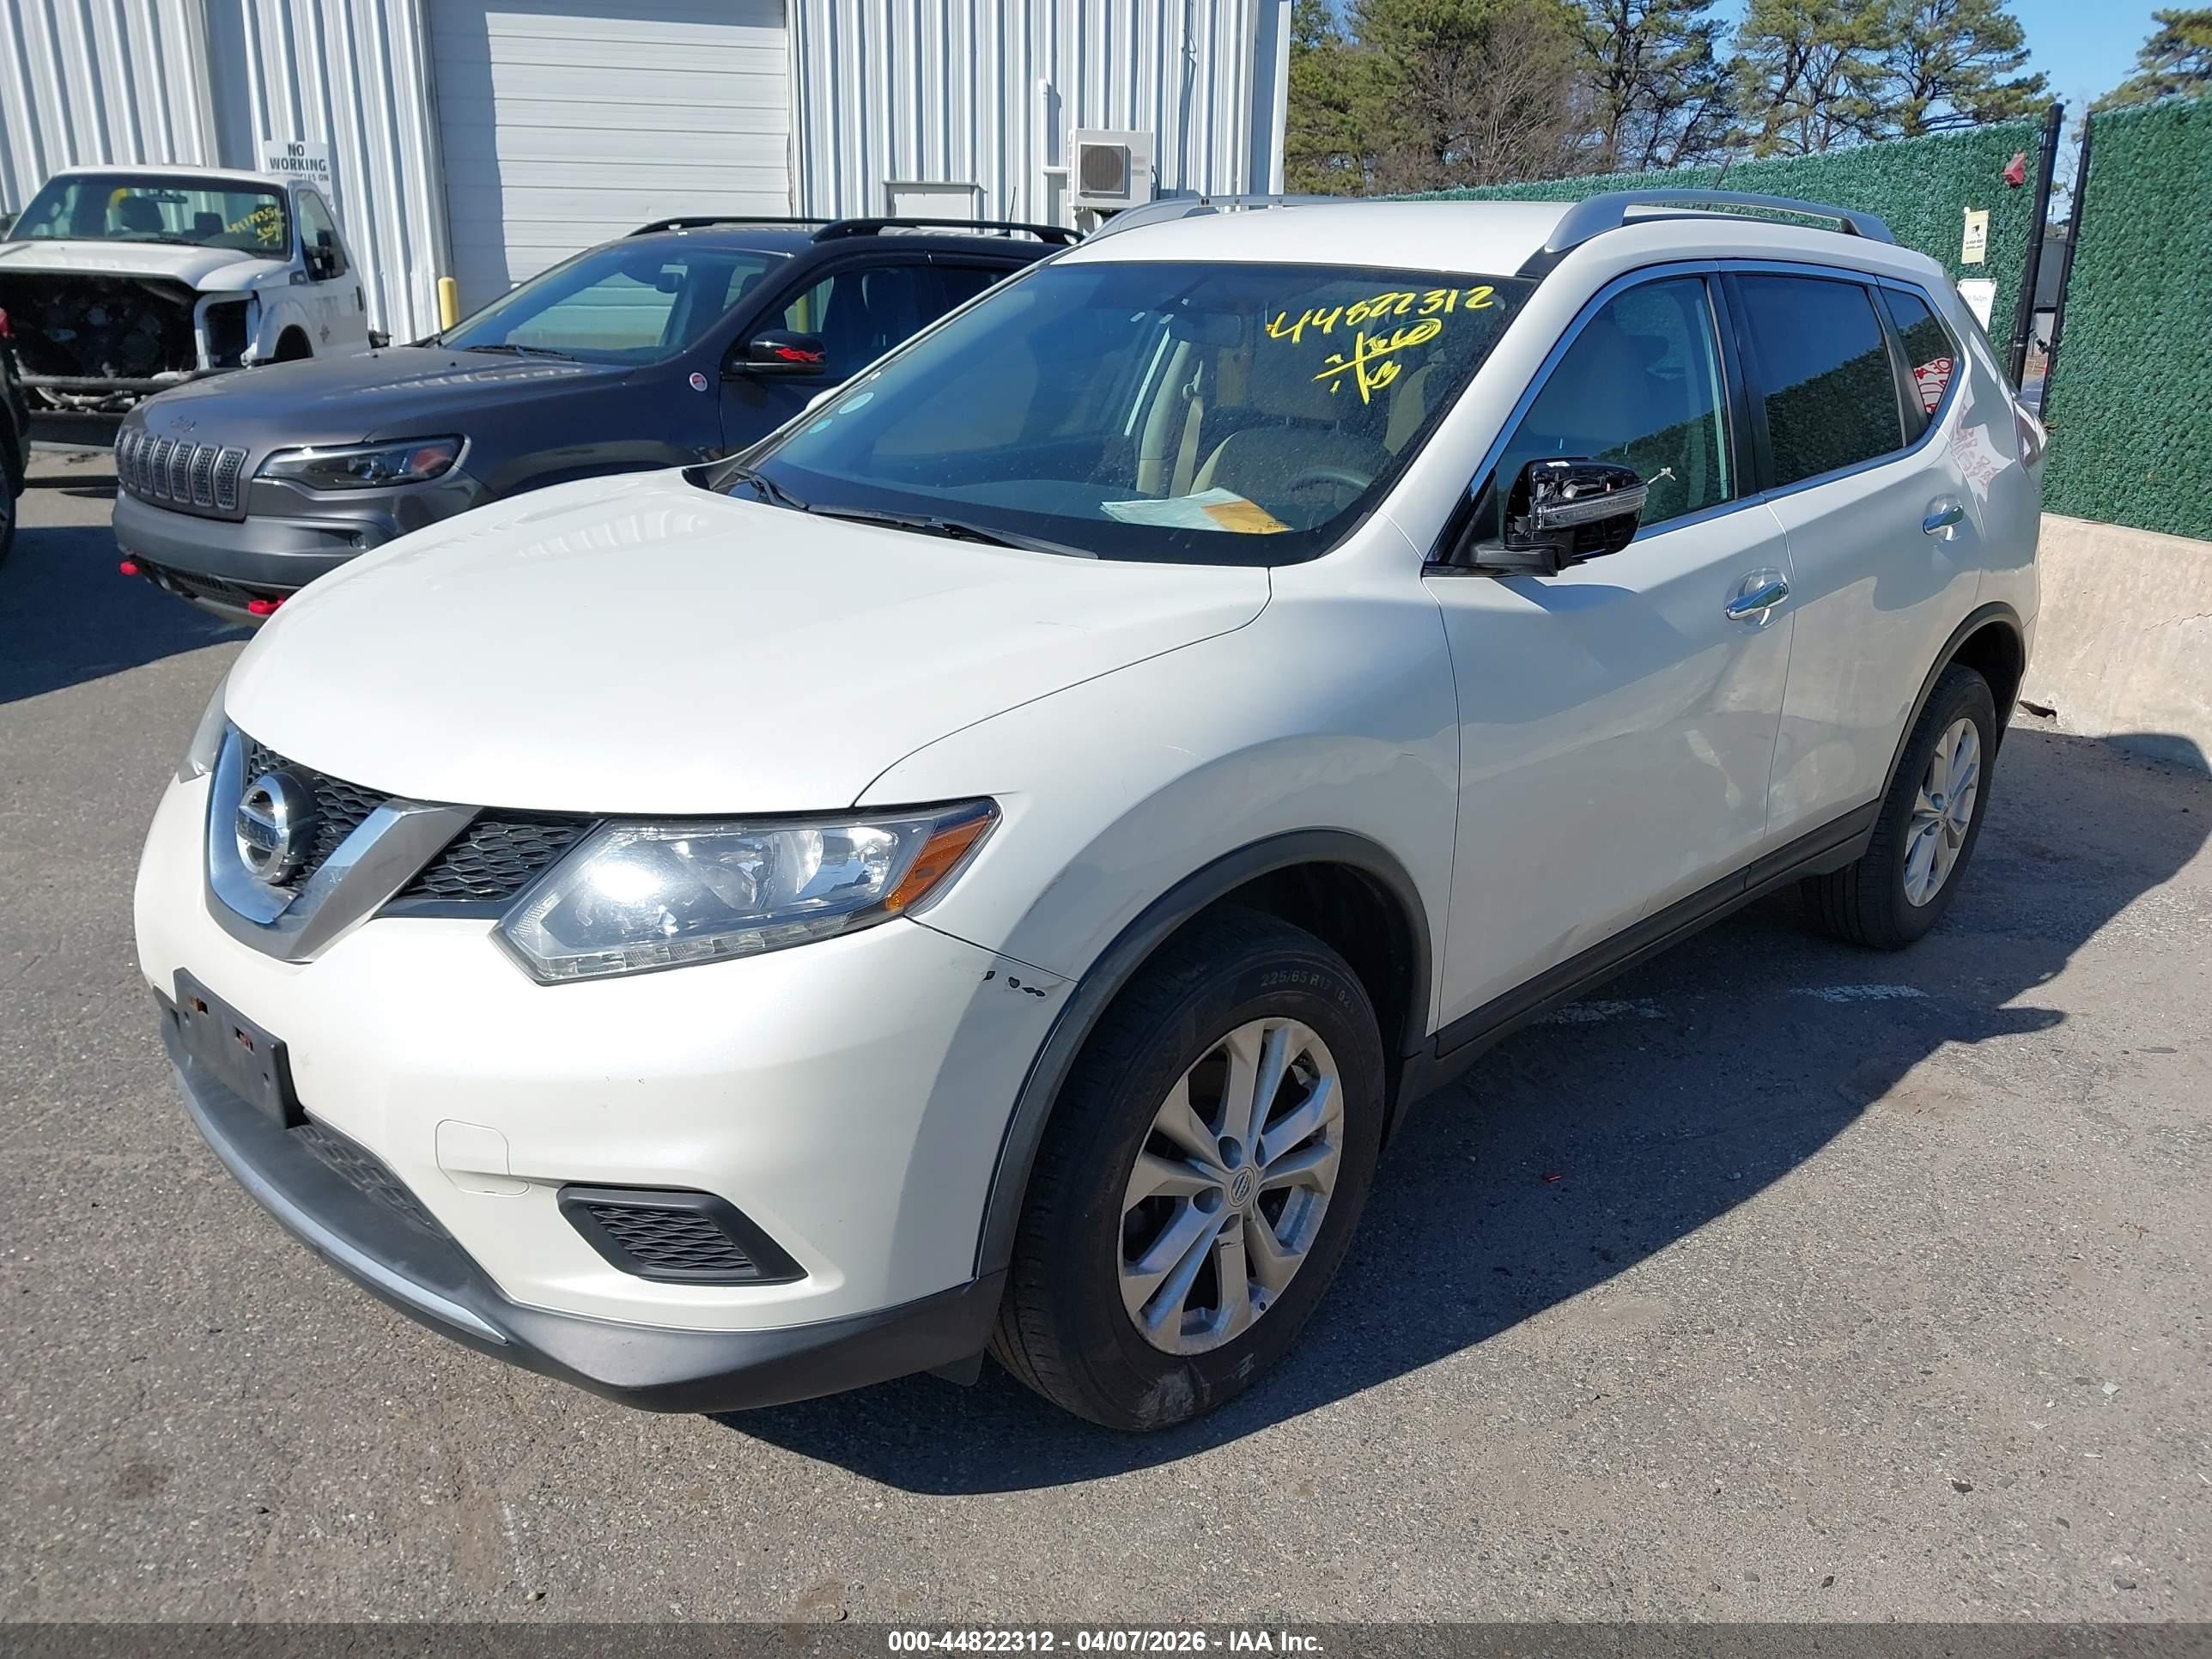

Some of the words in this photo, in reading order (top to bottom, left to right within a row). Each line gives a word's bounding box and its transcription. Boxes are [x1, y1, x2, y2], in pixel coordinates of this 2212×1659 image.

[288, 143, 305, 156] NO
[270, 157, 327, 172] WORKING
[319, 173, 329, 182] ON
[1269, 286, 1496, 343] 44822312
